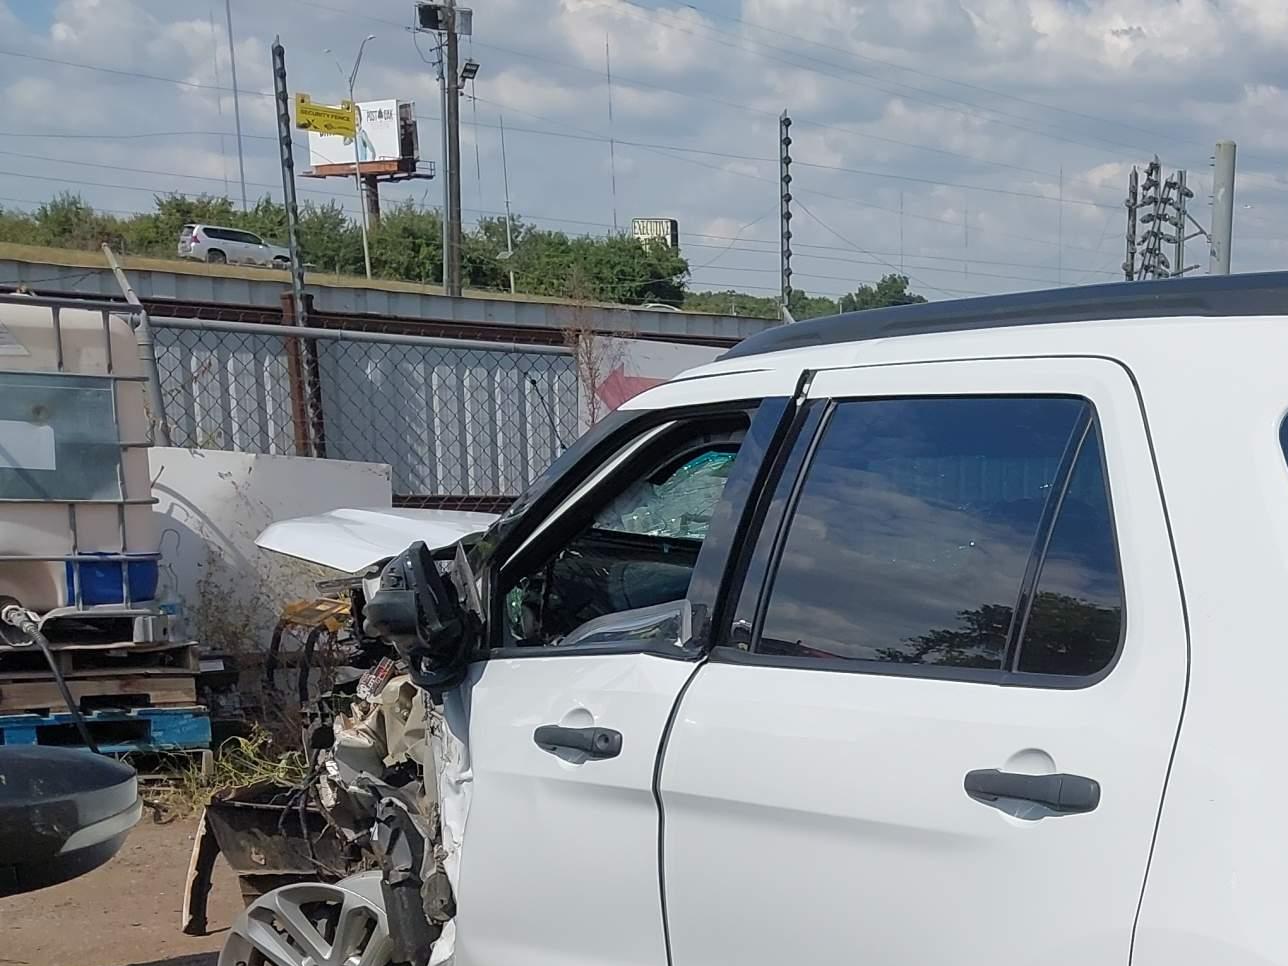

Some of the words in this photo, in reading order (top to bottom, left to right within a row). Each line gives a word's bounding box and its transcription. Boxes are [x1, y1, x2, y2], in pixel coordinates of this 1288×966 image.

[300, 109, 330, 119] SECURITY
[331, 114, 351, 122] FENCE
[632, 220, 671, 236] EXECUTIVE
